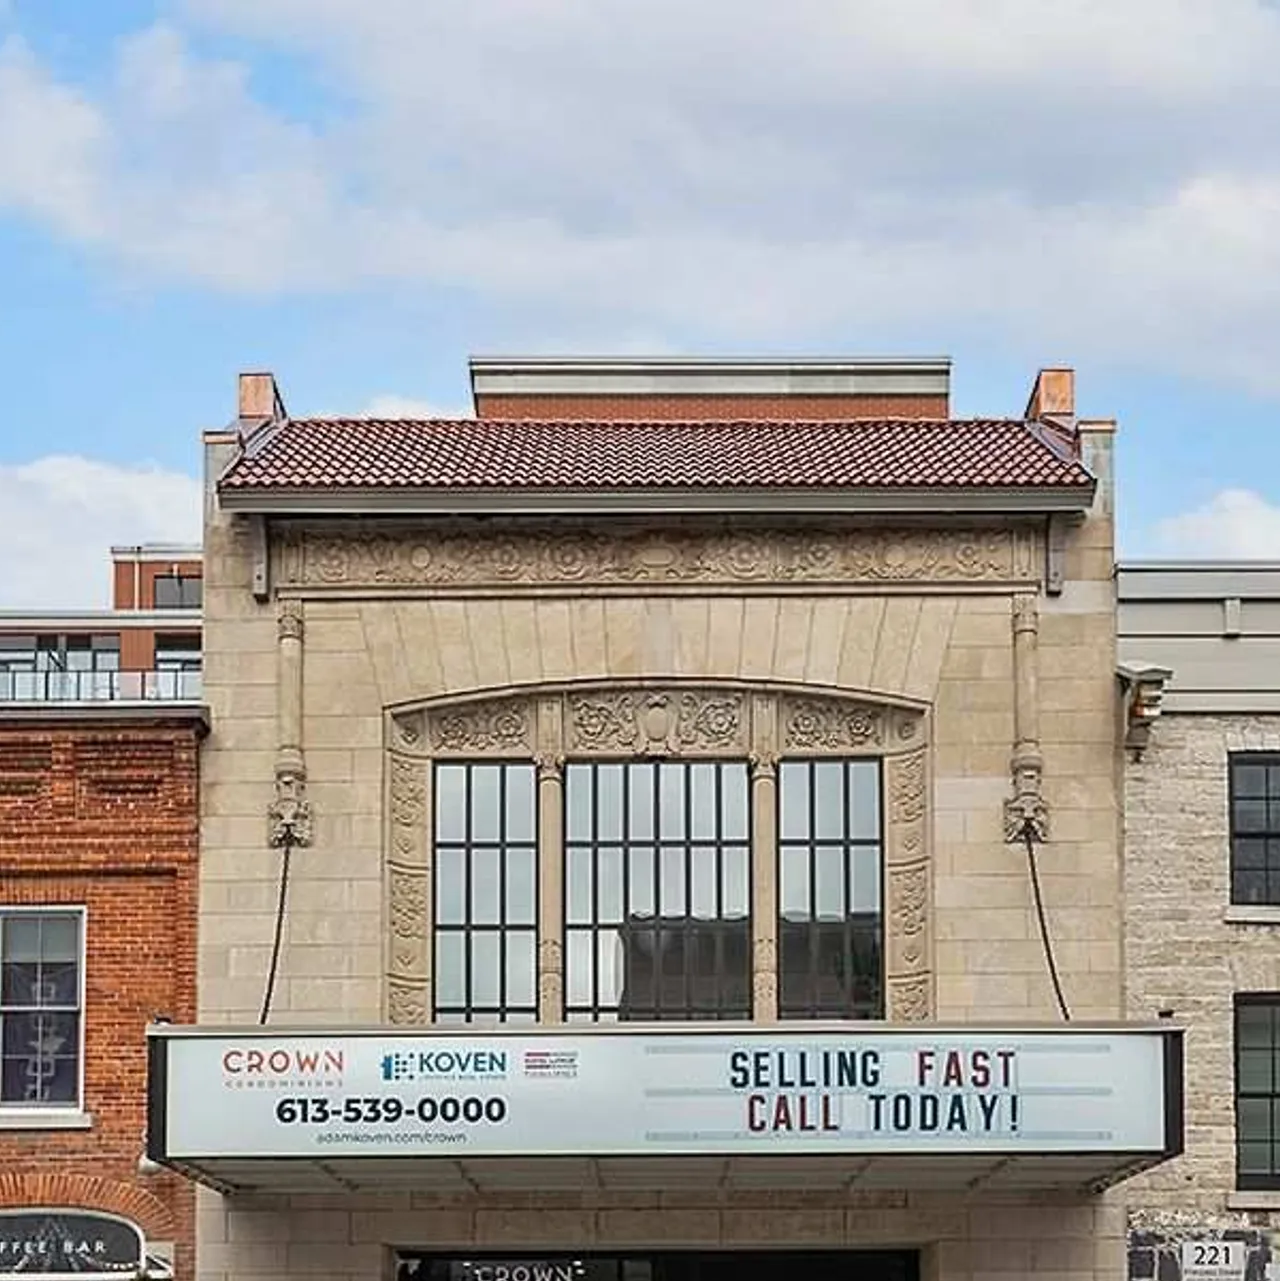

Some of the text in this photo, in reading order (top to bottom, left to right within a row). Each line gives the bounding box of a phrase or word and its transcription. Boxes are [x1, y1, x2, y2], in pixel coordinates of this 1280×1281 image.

[223, 1050, 343, 1073] CROWN
[419, 1051, 507, 1073] KOVEN
[730, 1050, 1016, 1088] SELLING FAST
[276, 1098, 506, 1123] 613-539-0000
[747, 1094, 1018, 1132] CALL TODAY!
[63, 1239, 107, 1253] BAR
[1194, 1245, 1230, 1265] 221
